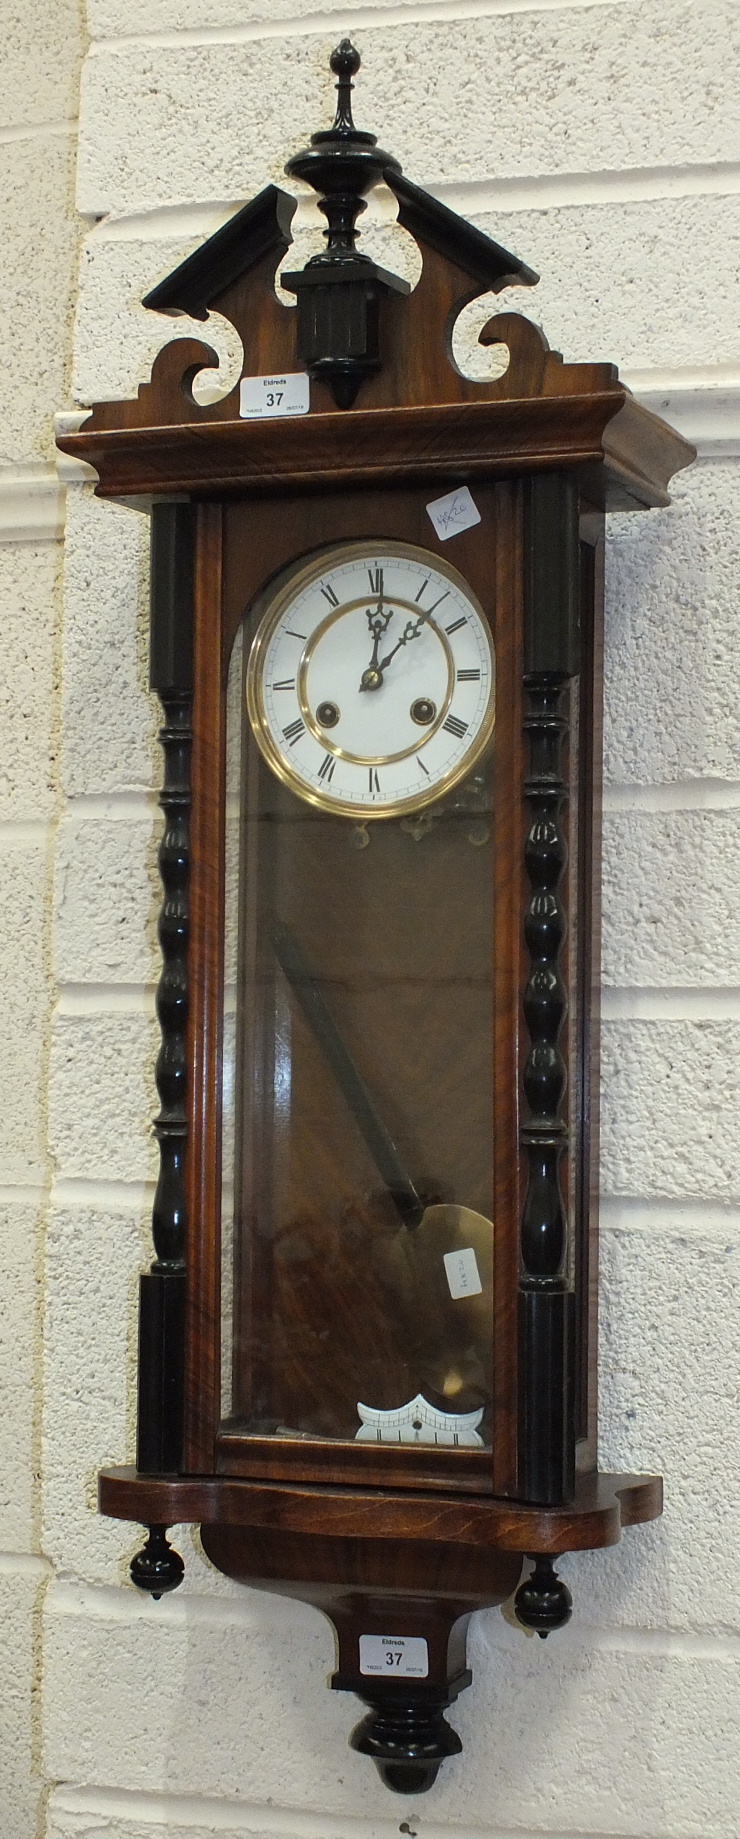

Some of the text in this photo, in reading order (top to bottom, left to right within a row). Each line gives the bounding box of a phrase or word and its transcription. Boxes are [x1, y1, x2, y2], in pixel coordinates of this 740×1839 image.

[263, 379, 287, 387] Eldreds
[266, 392, 284, 407] 37
[367, 568, 384, 594] XII
[414, 579, 429, 603] I
[445, 616, 468, 636] II
[457, 668, 481, 682] III
[282, 718, 306, 748] VIII
[442, 714, 469, 740] IIII
[317, 753, 337, 783] VII
[381, 1638, 405, 1646] Eldreds
[385, 1652, 403, 1666] 37
